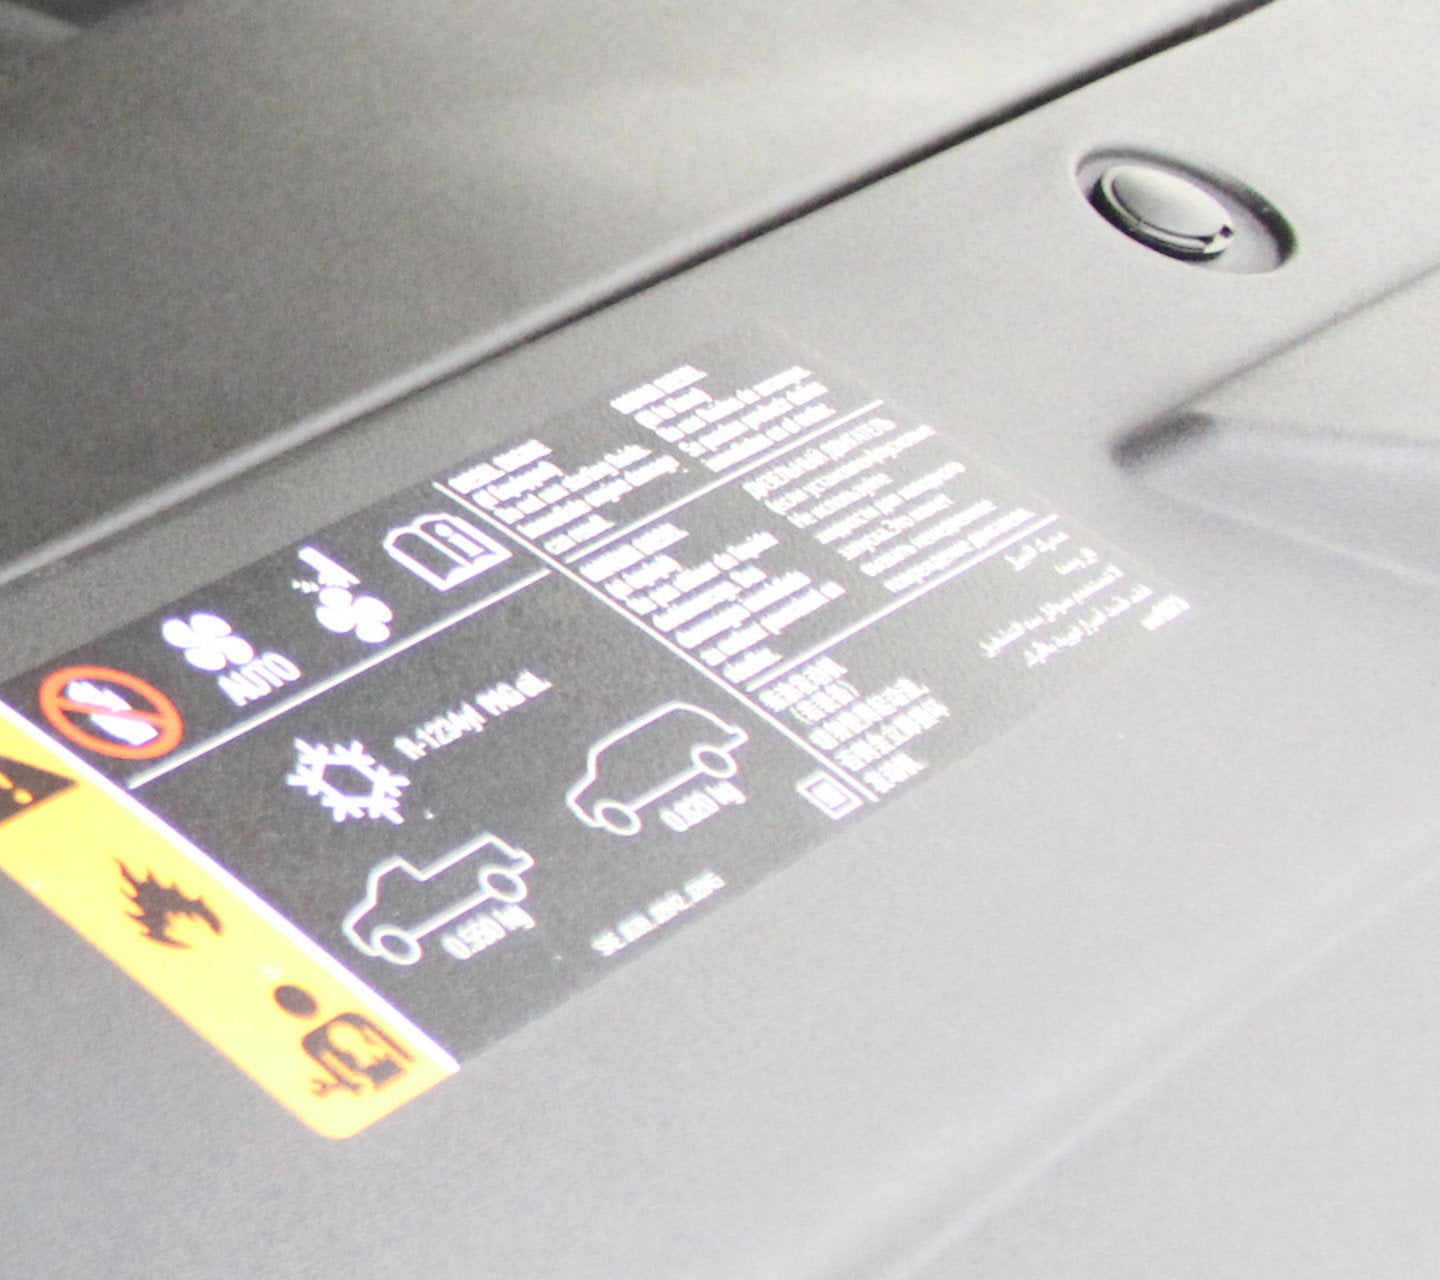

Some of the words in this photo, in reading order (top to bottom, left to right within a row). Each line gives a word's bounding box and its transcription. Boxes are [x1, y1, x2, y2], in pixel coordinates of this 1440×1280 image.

[218, 652, 300, 706] AUTO
[394, 703, 485, 760] R-1234yf
[476, 683, 526, 716] PAG
[705, 776, 746, 805] kg
[492, 897, 535, 931] kg
